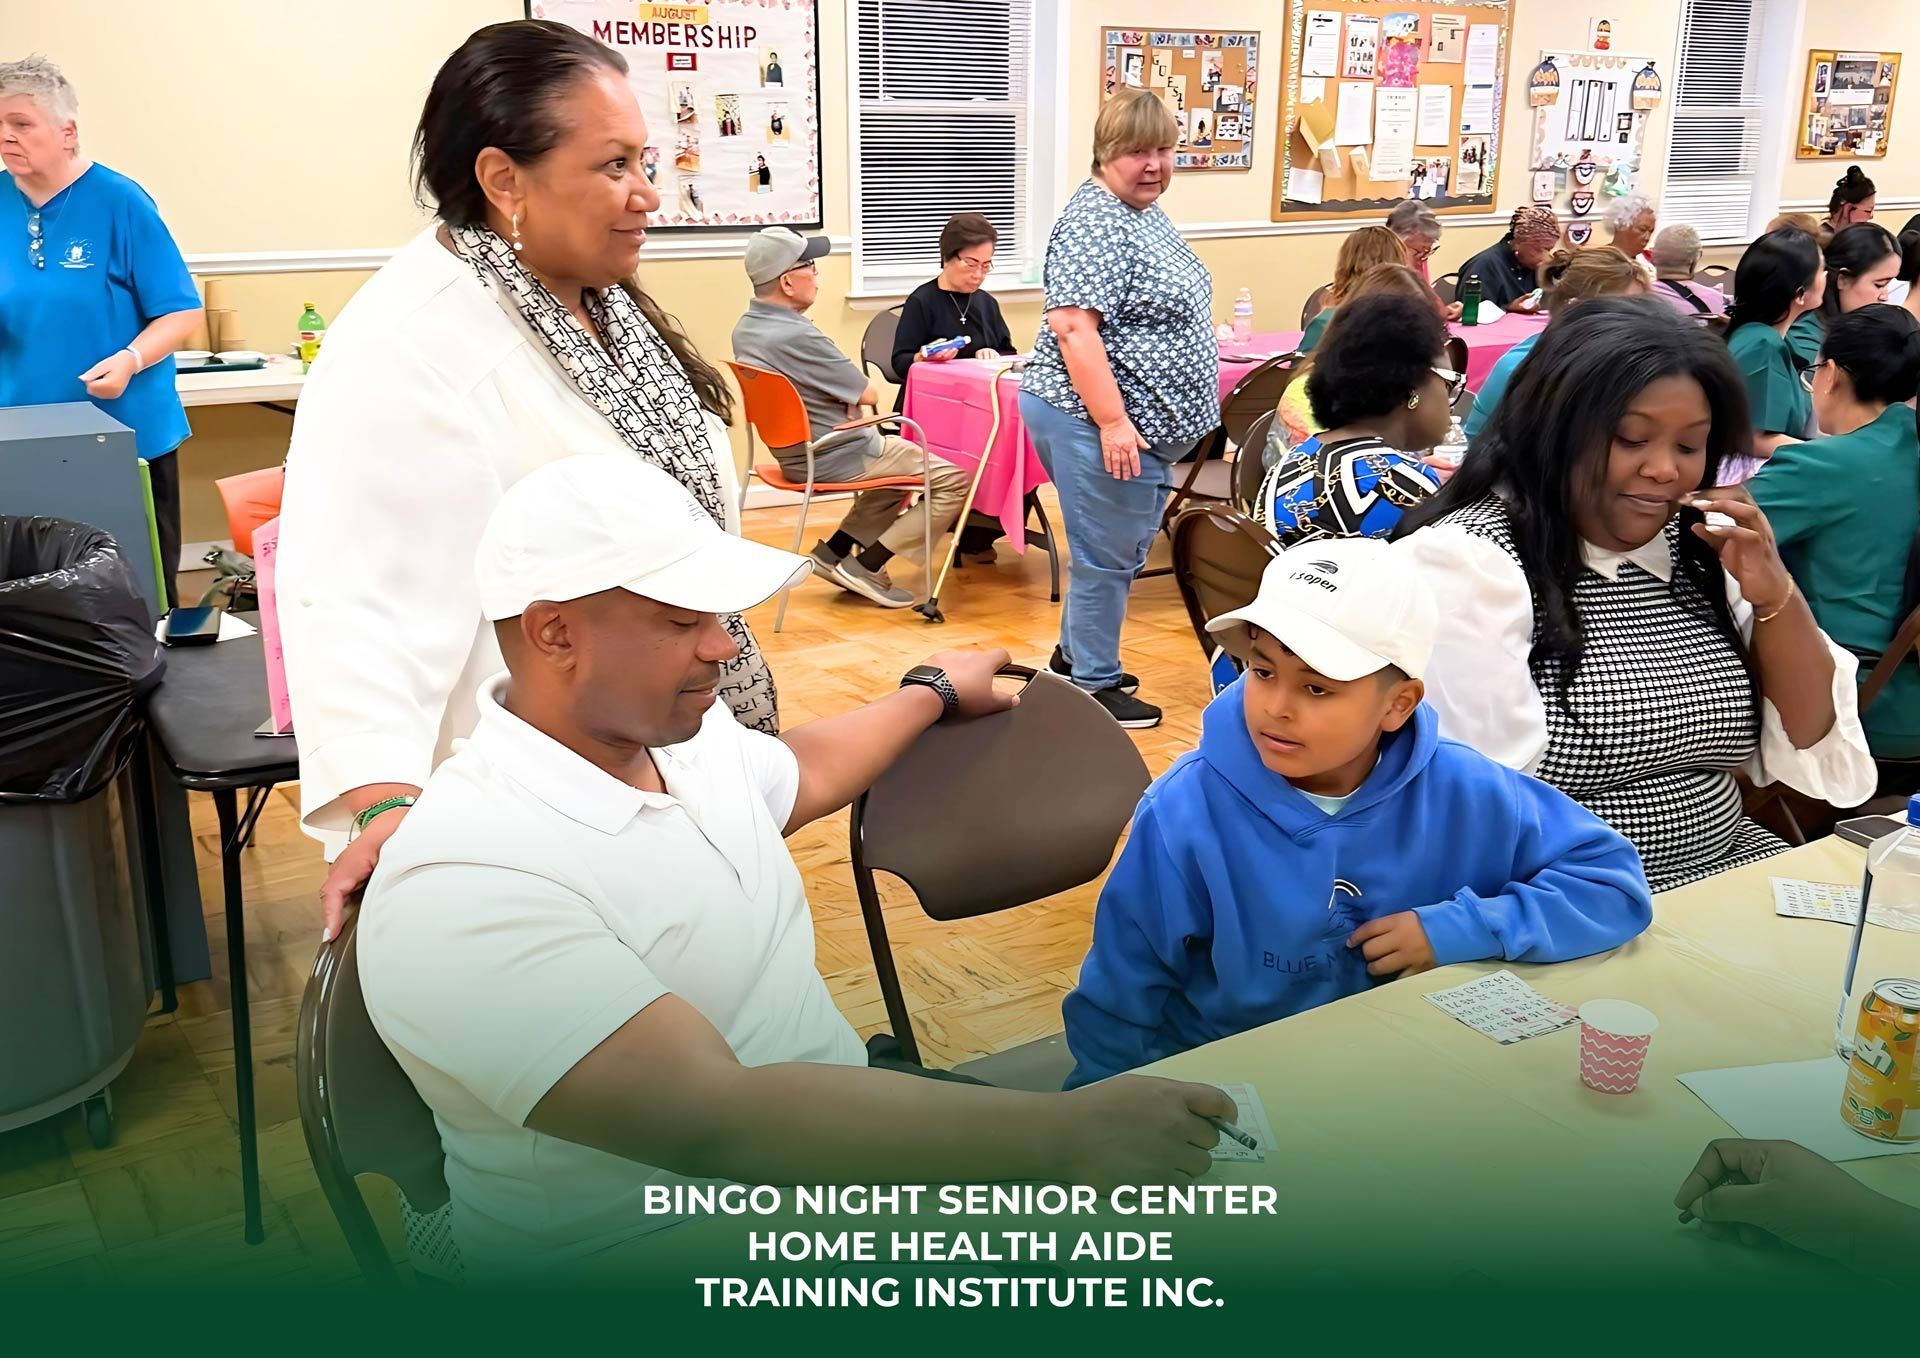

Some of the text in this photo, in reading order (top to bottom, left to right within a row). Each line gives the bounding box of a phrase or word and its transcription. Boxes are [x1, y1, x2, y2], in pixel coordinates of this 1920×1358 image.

[652, 7, 698, 21] AUGUST
[592, 20, 757, 48] MEMBERSHIP
[1263, 950, 1317, 975] BLUE
